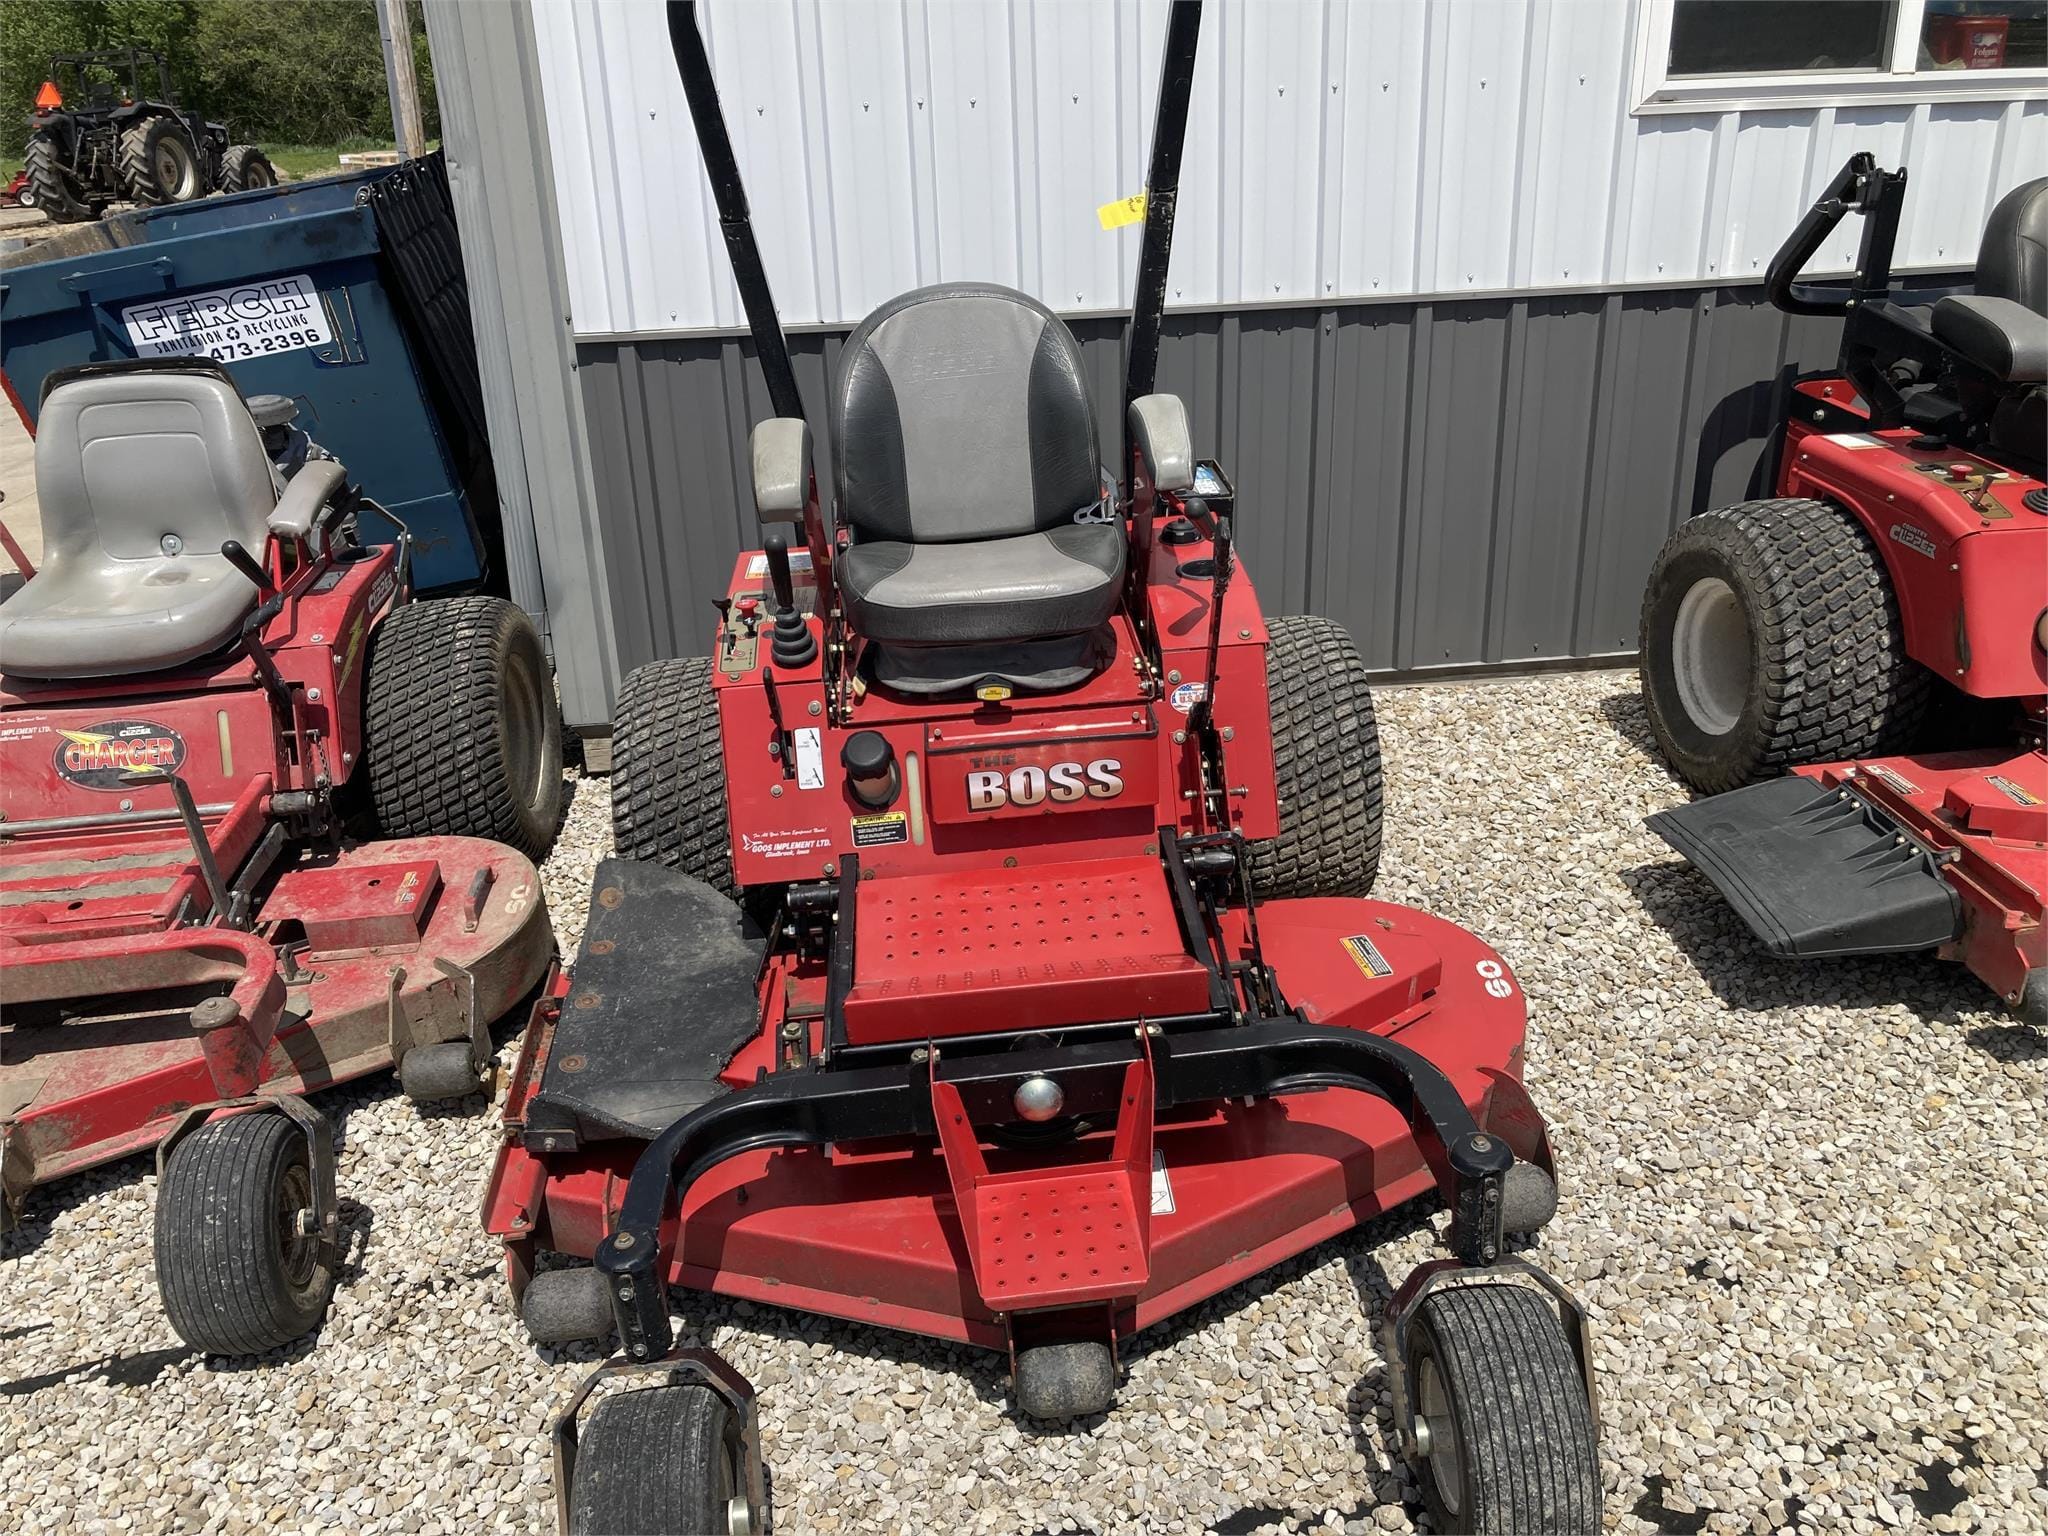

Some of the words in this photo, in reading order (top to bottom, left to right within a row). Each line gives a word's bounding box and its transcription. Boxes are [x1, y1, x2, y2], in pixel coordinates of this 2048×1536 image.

[129, 279, 311, 340] FERCH
[154, 331, 223, 354] SANITATION
[243, 313, 309, 336] RECYCLING
[1889, 524, 1937, 560] CLIPPER
[64, 737, 176, 772] CHARGER
[970, 753, 1017, 769] THE
[967, 757, 1125, 814] BOSS
[751, 843, 773, 853] GOOS
[773, 840, 815, 851] IMPLEMENT
[815, 838, 831, 847] LTD.
[1475, 959, 1513, 998] 60
